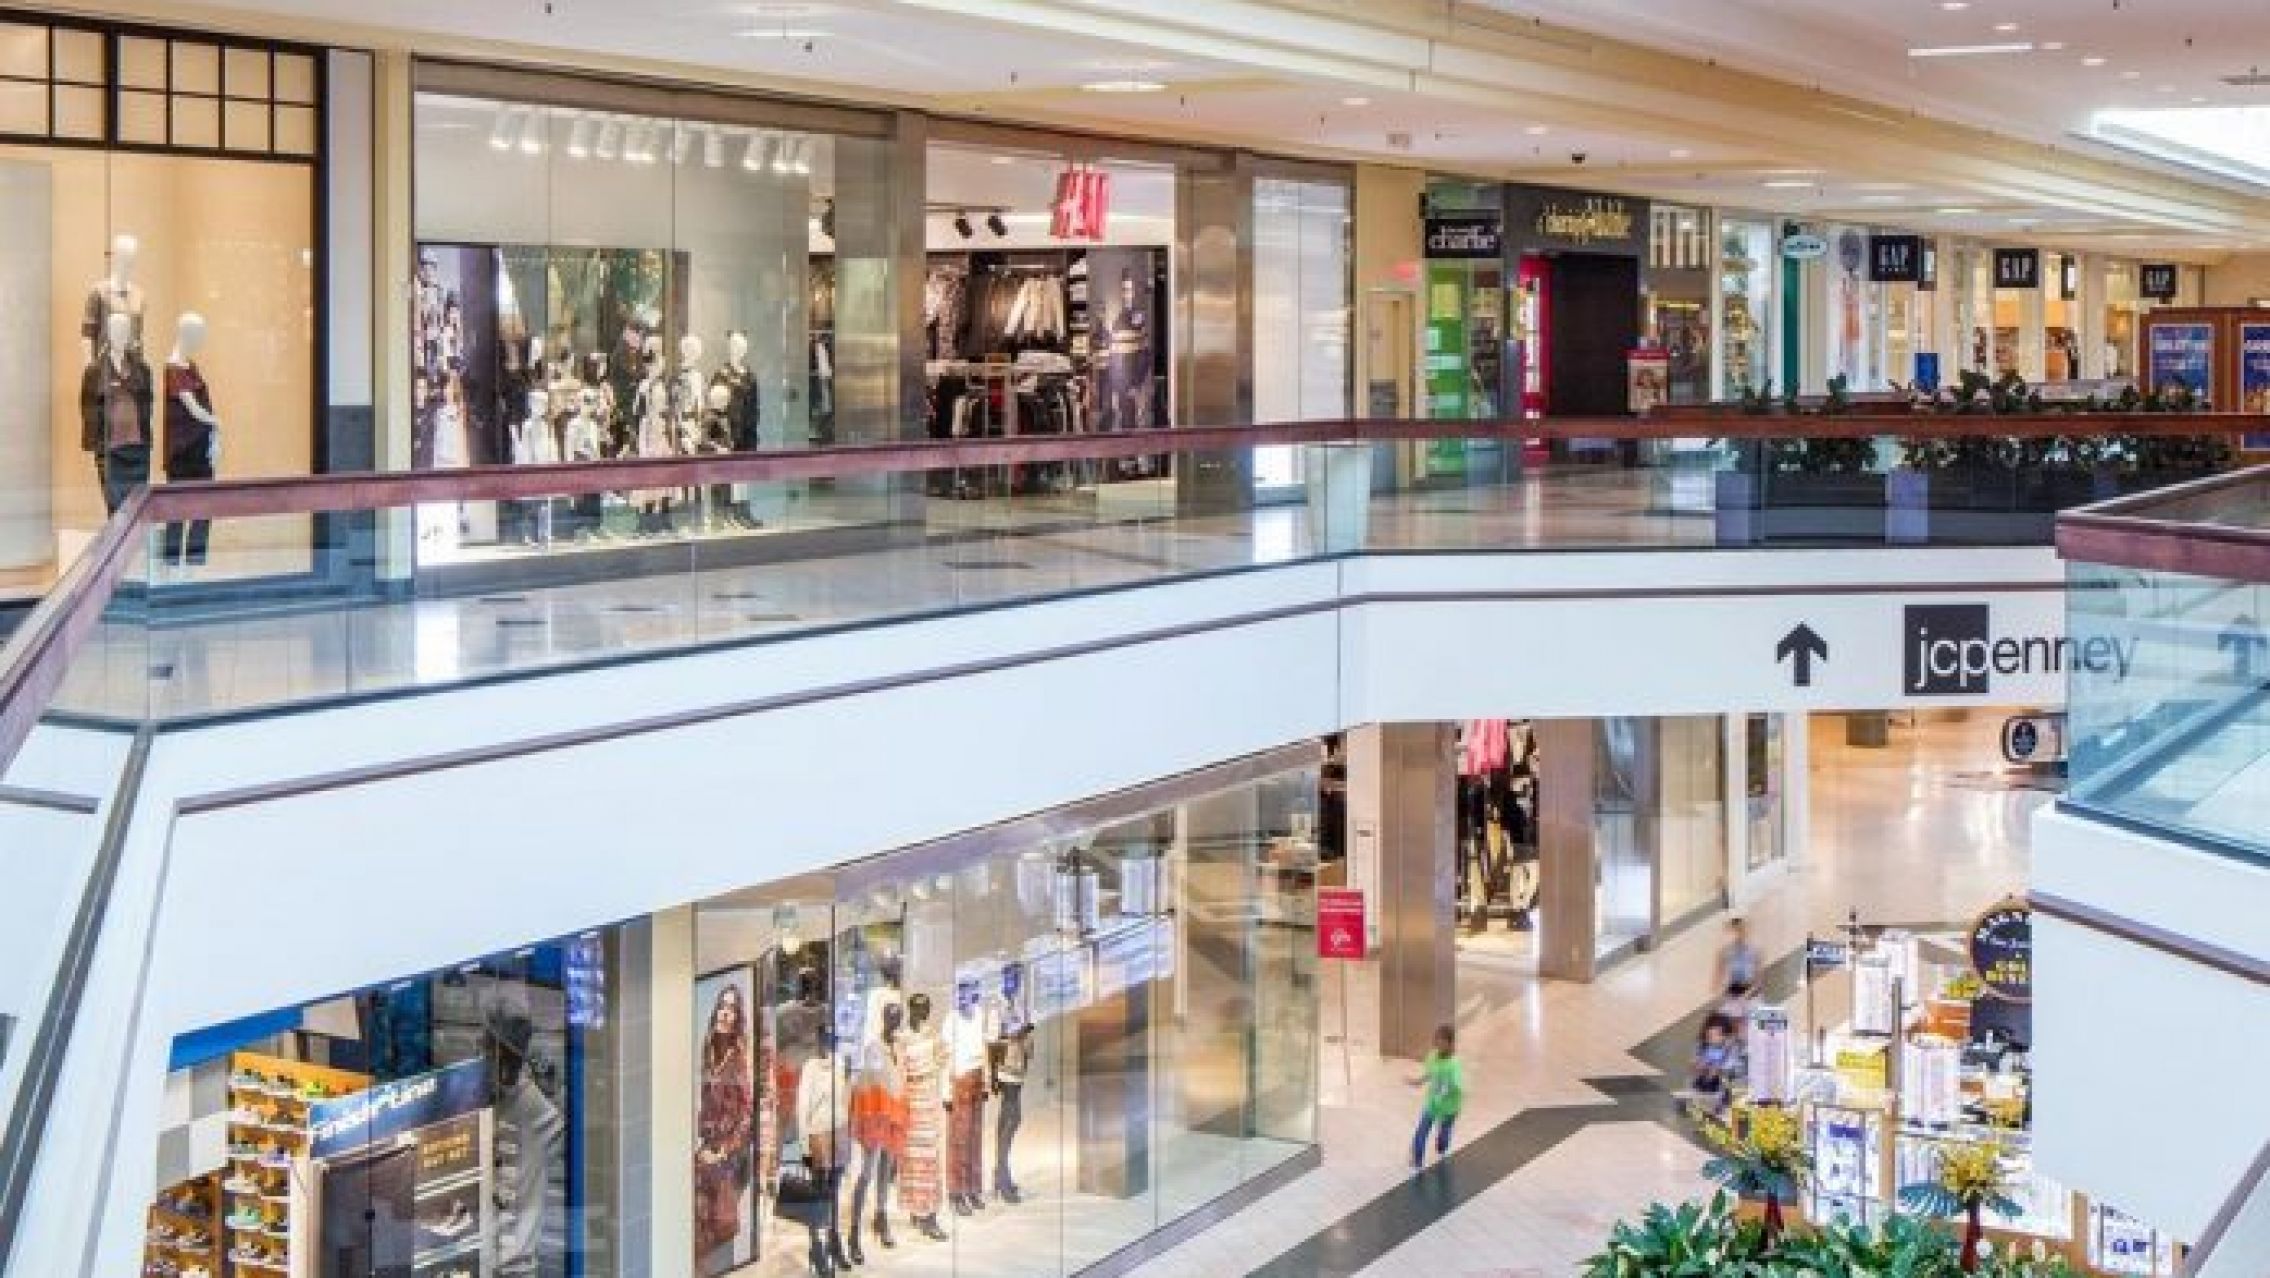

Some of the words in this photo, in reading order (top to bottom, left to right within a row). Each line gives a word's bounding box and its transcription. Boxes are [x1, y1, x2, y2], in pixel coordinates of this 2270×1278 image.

[1879, 245, 1909, 265] GAP
[2000, 257, 2033, 279] GAP
[1914, 626, 2140, 689] jcpenney
